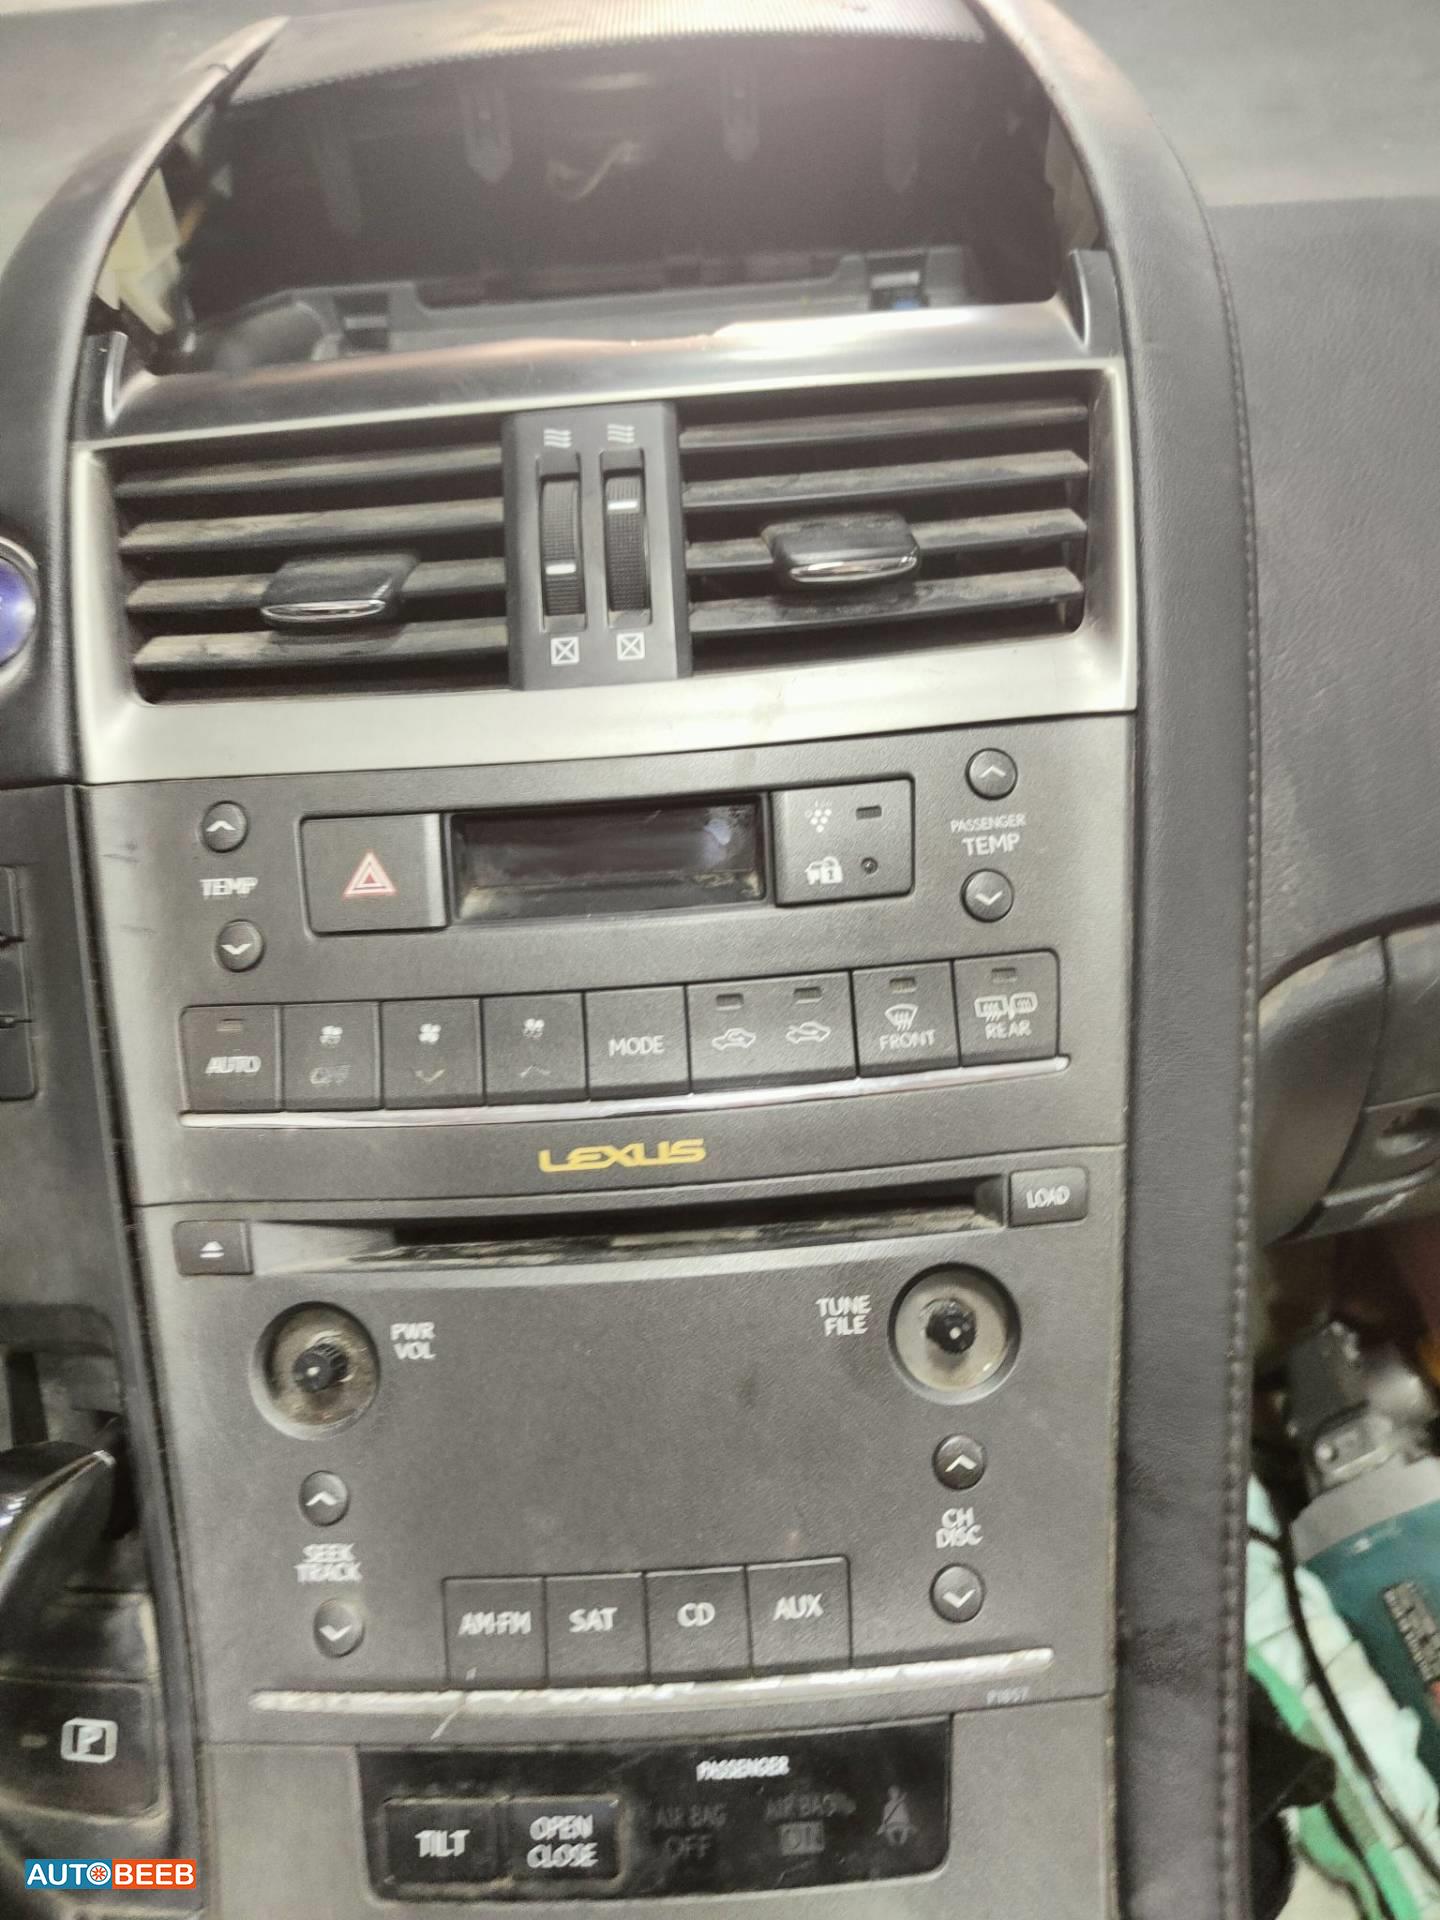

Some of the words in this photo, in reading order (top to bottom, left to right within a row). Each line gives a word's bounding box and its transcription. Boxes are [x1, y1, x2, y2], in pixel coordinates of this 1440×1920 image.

[950, 813, 1026, 833] PASSENGER
[962, 832, 1021, 857] TEMP
[200, 877, 257, 899] TEMP
[879, 1029, 936, 1051] FRONT
[985, 1020, 1031, 1040] REAR
[608, 1035, 664, 1057] MODE
[205, 1054, 261, 1076] AUTO
[538, 1138, 707, 1173] LEXUS
[1026, 1185, 1070, 1209] LOAD
[815, 1295, 872, 1317] TUNE
[390, 1322, 436, 1341] PWR
[824, 1315, 868, 1336] FILE
[393, 1341, 437, 1360] VOL
[941, 1507, 975, 1529] CH
[935, 1525, 984, 1549] DISC
[677, 1603, 715, 1627] CD
[773, 1593, 824, 1621] AUX
[568, 1606, 618, 1632] SAT
[696, 1756, 790, 1782] PASSENGER
[529, 1815, 594, 1841] OPEN
[415, 1829, 470, 1858] TILT
[527, 1842, 600, 1869] CLOSE
